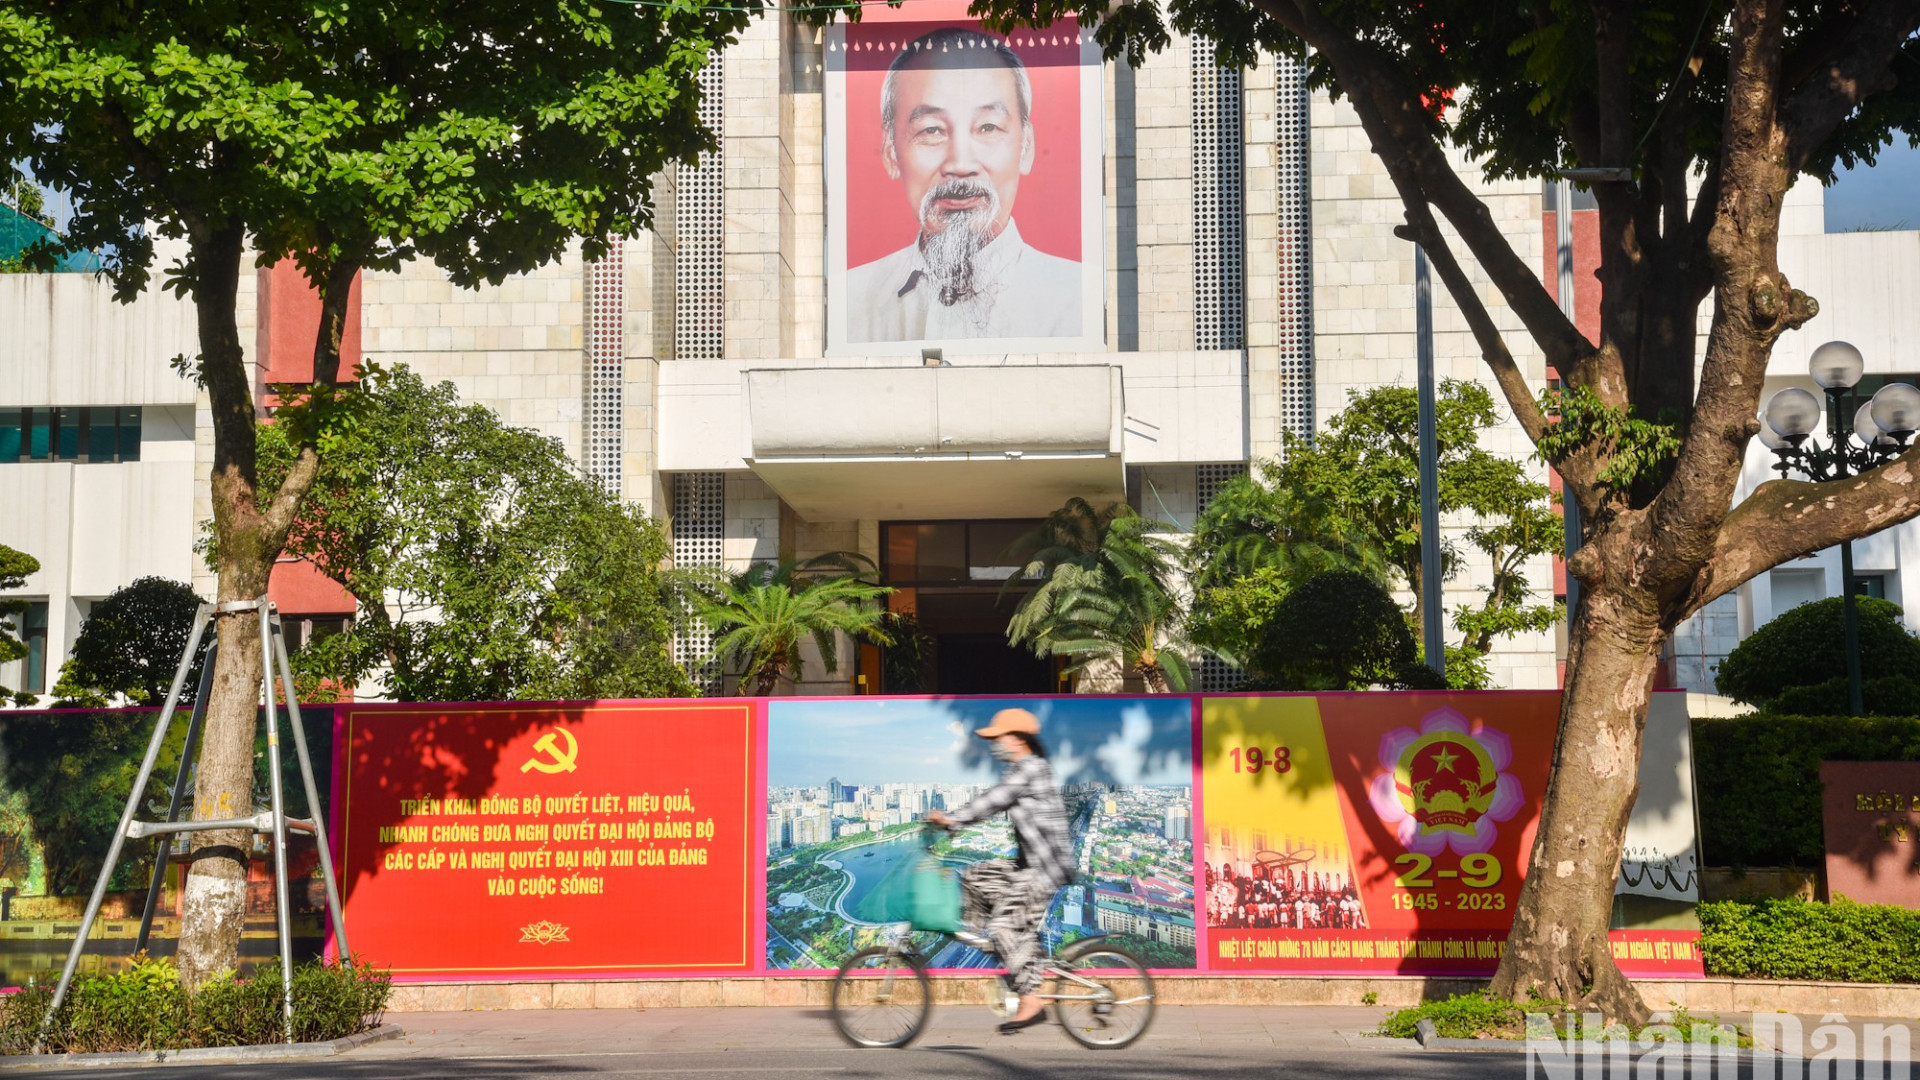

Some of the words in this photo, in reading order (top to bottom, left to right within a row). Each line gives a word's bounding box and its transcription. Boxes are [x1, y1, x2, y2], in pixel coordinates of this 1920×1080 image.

[1230, 746, 1291, 774] 19-8
[400, 793, 440, 816] TRIỂN
[444, 799, 477, 816] KHAI
[480, 793, 519, 816] ĐỒNG
[522, 794, 542, 817] BỘ
[545, 791, 588, 816] QUYẾT
[592, 793, 624, 816] LIỆT,
[628, 792, 659, 816] HIỆU
[663, 788, 695, 814] QUẢ,
[379, 826, 428, 843] NHANH
[432, 822, 479, 842] CHÓNG
[483, 823, 511, 841] ĐƯA
[515, 824, 549, 844] NGHỊ
[553, 818, 595, 842] QUYẾT
[599, 822, 622, 843] ĐẠI
[627, 819, 649, 842] HỘI
[653, 815, 692, 839] ĐẢNG
[696, 818, 714, 841] BỘ
[385, 849, 413, 870] CÁC
[417, 846, 445, 870] CẤP
[449, 849, 467, 869] VÀ
[471, 851, 505, 872] NGHỊ
[509, 844, 552, 870] QUYẾT
[555, 850, 579, 871] ĐẠI
[583, 847, 606, 870] HỘI
[610, 849, 633, 867] XIII
[637, 843, 665, 867] CỦA
[669, 842, 707, 866] ĐẢNG
[1395, 853, 1502, 888] 2-9
[488, 875, 515, 896] VÀO
[519, 874, 556, 898] CUỘC
[560, 872, 604, 895] SỐNG!
[1392, 893, 1439, 910] 1945
[1457, 893, 1505, 910] 2023
[1219, 937, 1240, 962] NHIỆT
[1241, 937, 1256, 962] LIỆT
[1257, 937, 1277, 958] CHÀO
[1278, 936, 1300, 958] MỪNG
[1312, 937, 1330, 958] NĂM
[1331, 937, 1350, 958] CÁCH
[1351, 940, 1374, 962] MẠNG
[1375, 937, 1399, 958] THÁNG
[1400, 937, 1416, 958] TÁM
[1418, 937, 1442, 958] THÀNH
[1443, 937, 1464, 958] CÔNG
[1465, 937, 1475, 958] VÀ
[1477, 935, 1497, 960] QUỐC
[1612, 933, 1629, 959] CHỦ
[1629, 938, 1654, 959] NGHĨA
[1654, 938, 1671, 964] VIỆT
[1672, 942, 1692, 960] NAM
